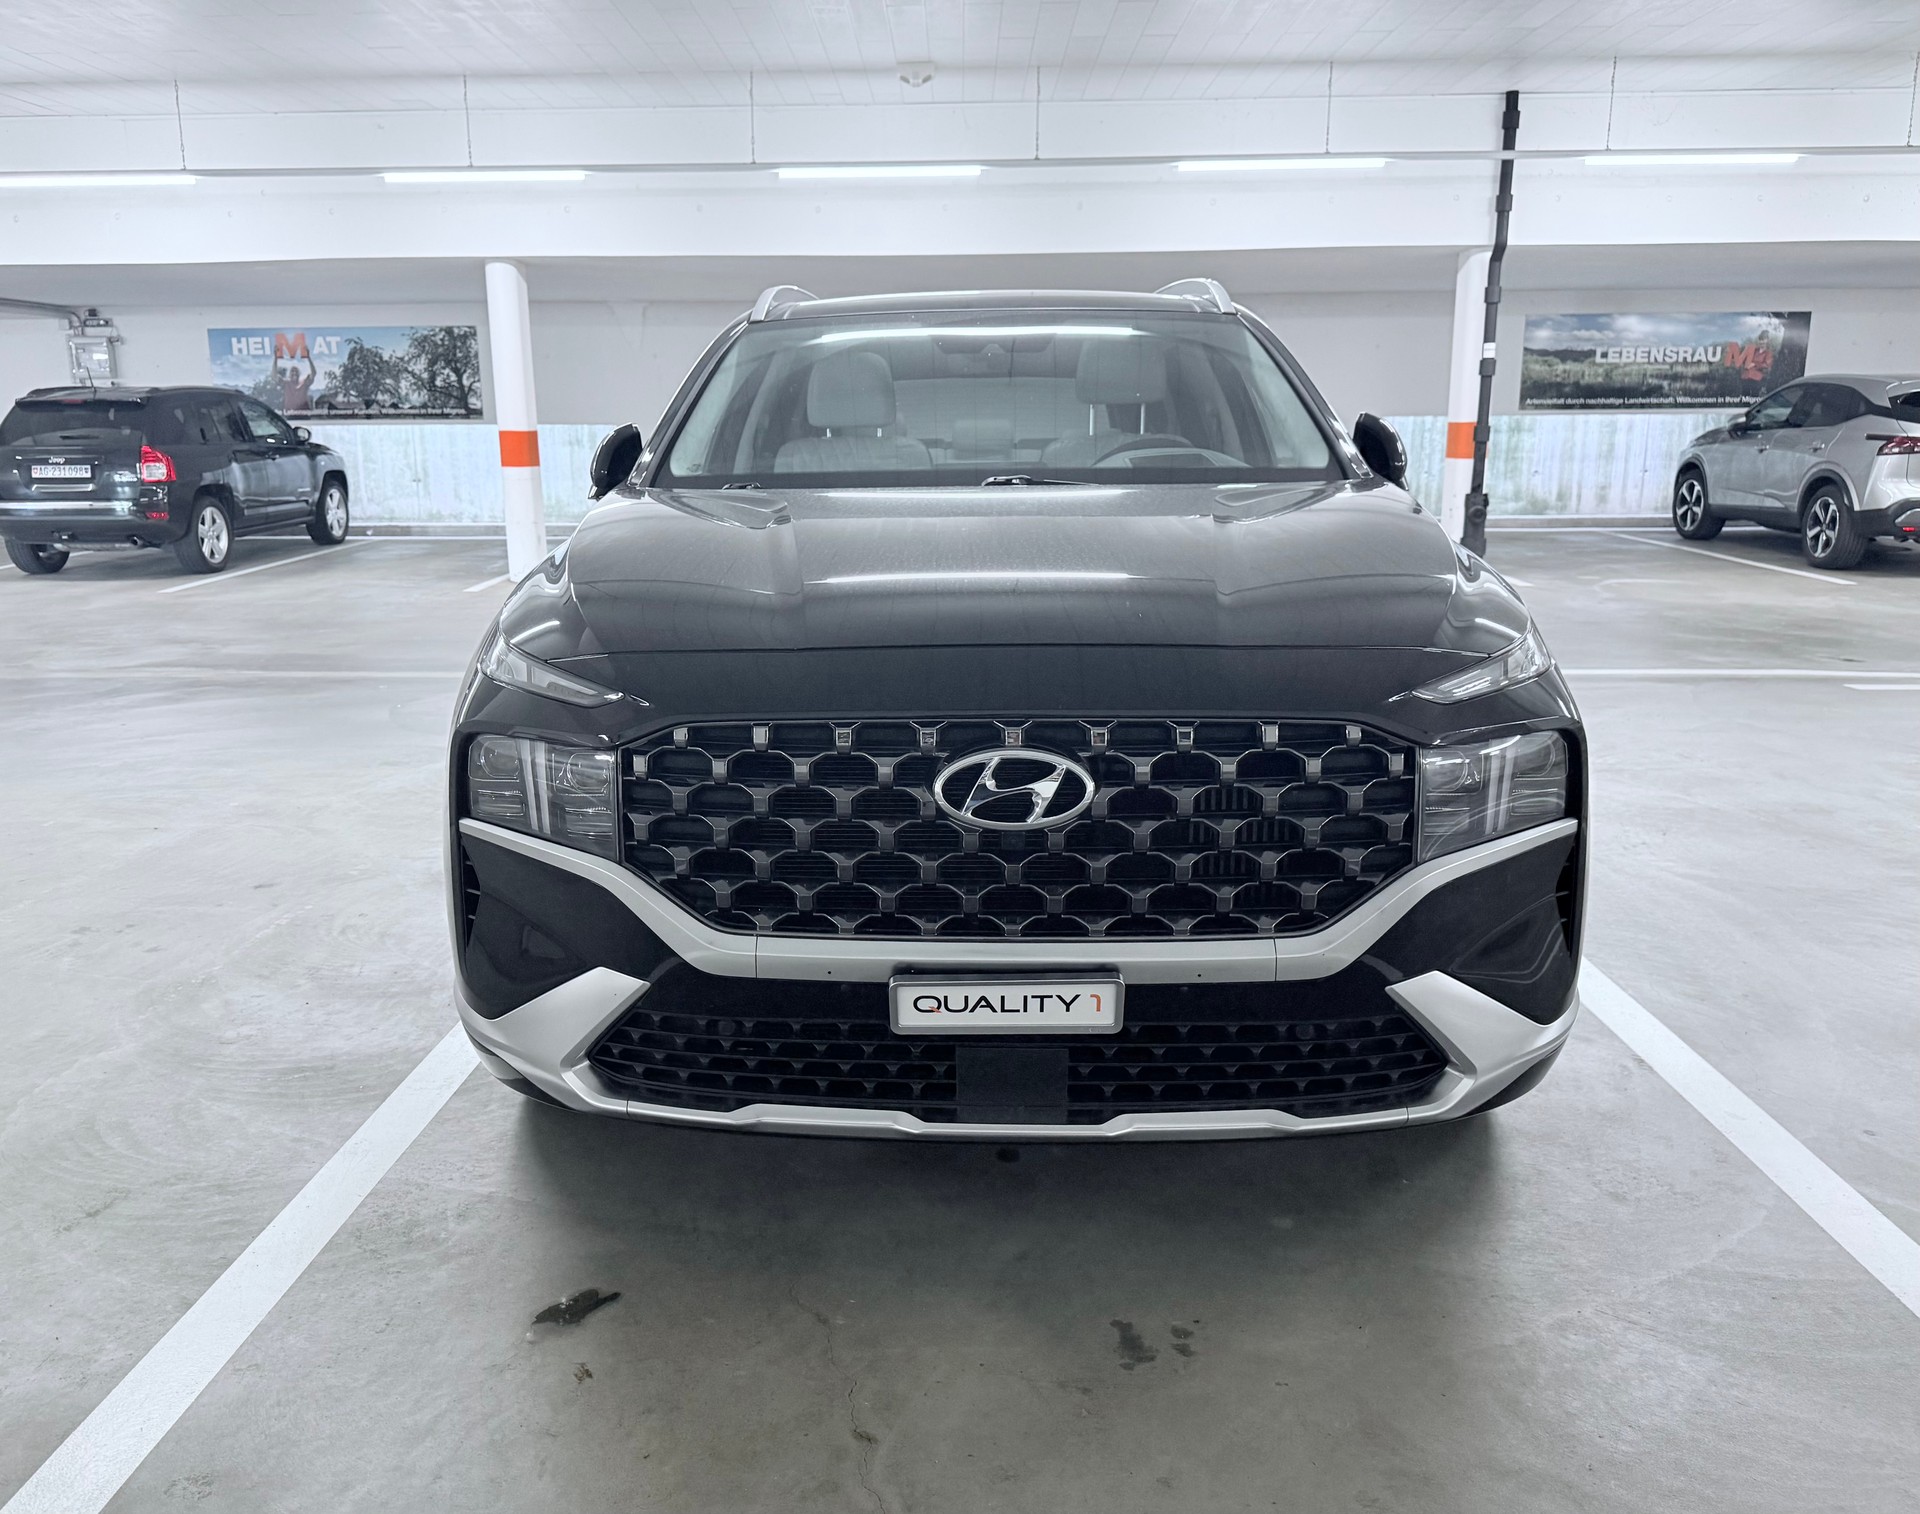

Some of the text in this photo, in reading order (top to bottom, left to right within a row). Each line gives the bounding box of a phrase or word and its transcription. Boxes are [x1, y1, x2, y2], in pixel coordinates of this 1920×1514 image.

[1565, 397, 1585, 405] durch
[1676, 395, 1717, 404] Willkommen
[1741, 395, 1761, 404] Migro
[912, 994, 1102, 1014] QUALITY 1
